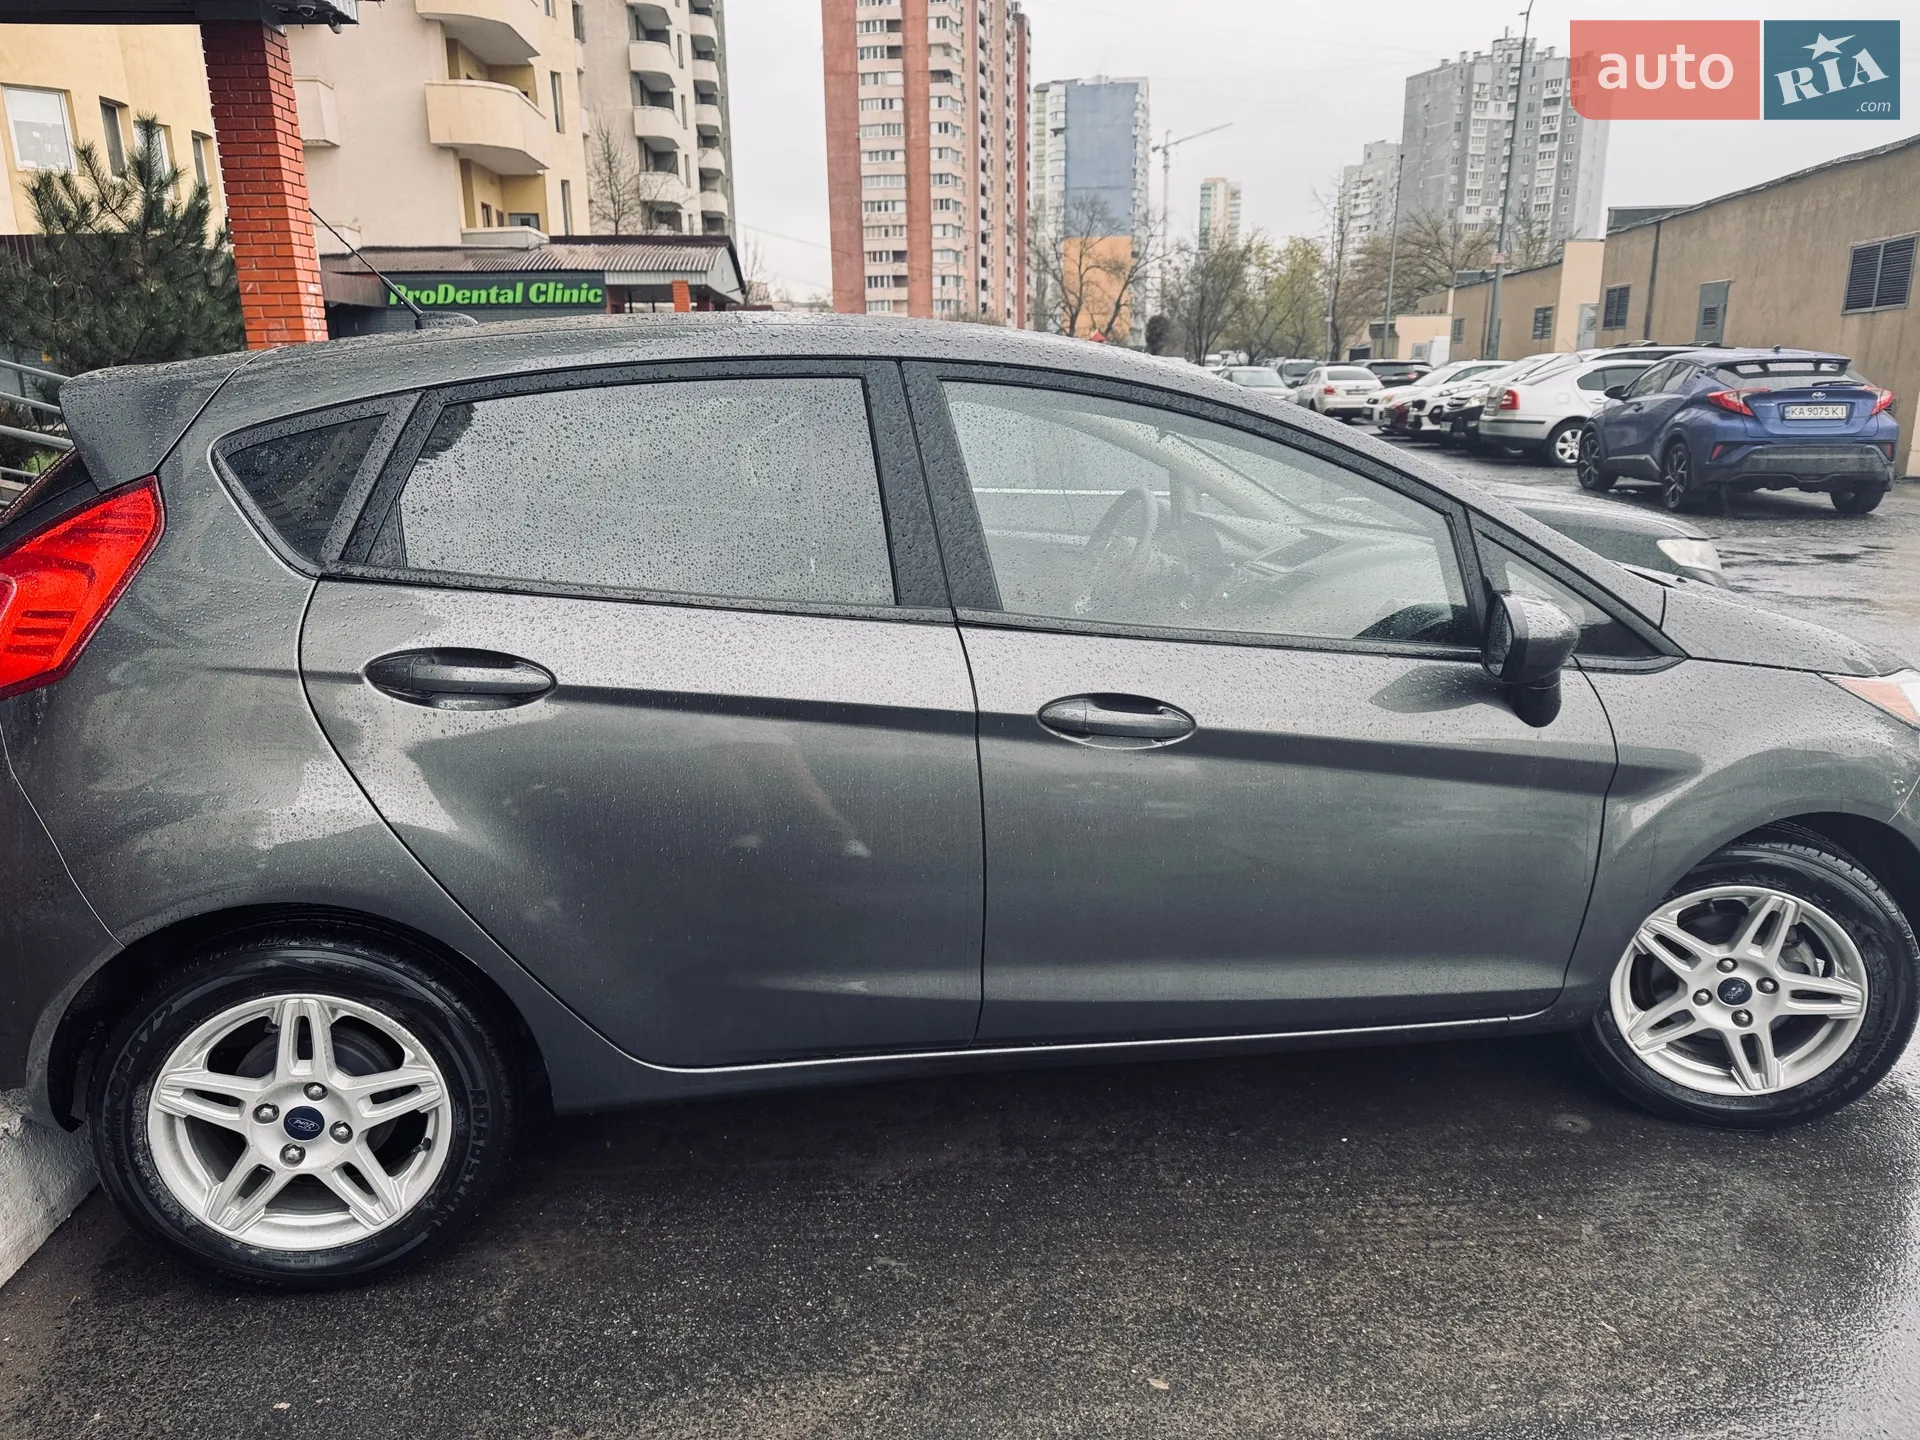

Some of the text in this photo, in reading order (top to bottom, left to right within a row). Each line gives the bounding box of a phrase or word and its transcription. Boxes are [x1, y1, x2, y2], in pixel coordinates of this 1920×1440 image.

[388, 281, 602, 305] ProDental Clinic
[1791, 407, 1805, 416] KA
[1807, 407, 1829, 416] 9075
